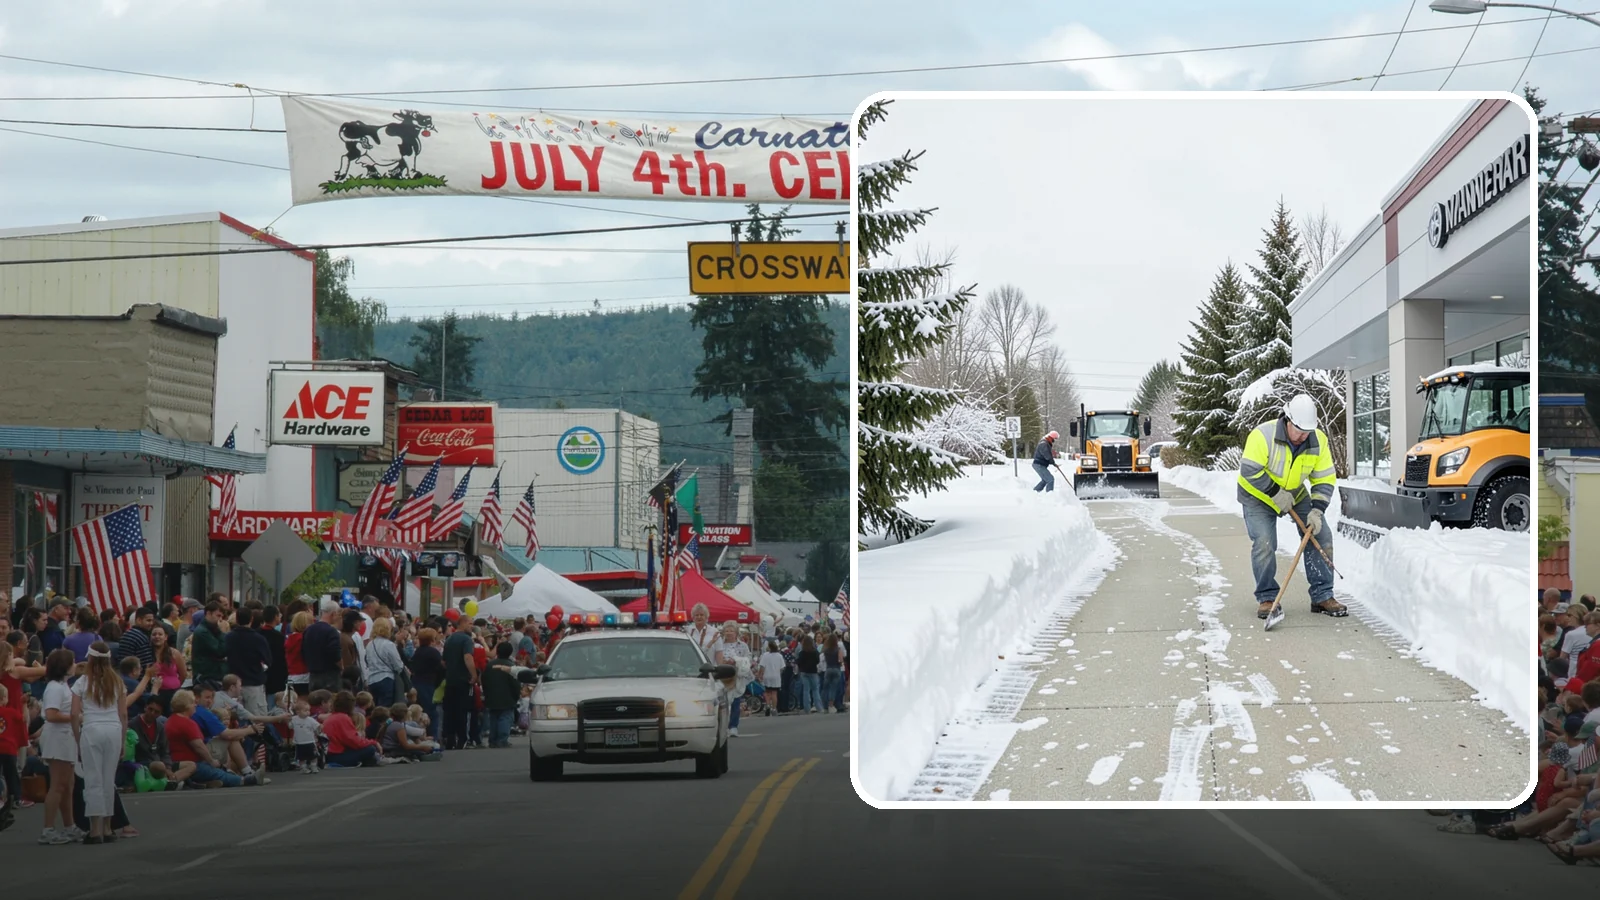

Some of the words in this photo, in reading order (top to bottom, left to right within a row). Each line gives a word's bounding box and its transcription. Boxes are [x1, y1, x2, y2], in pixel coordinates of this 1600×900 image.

[695, 121, 850, 150] Carnat
[481, 141, 605, 192] JULY
[632, 150, 747, 198] 4th.
[696, 254, 850, 280] CROSSWA
[282, 380, 374, 420] ACE
[405, 409, 453, 422] CEDAR
[461, 409, 485, 422] LOG
[283, 421, 371, 436] Hardware
[353, 467, 385, 480] Simpl
[95, 485, 124, 494] Vincent
[126, 485, 136, 494] de
[137, 485, 155, 495] Paul
[212, 516, 331, 536] HARDARE
[688, 526, 741, 535] CRNATION
[699, 535, 730, 543] GLASS
